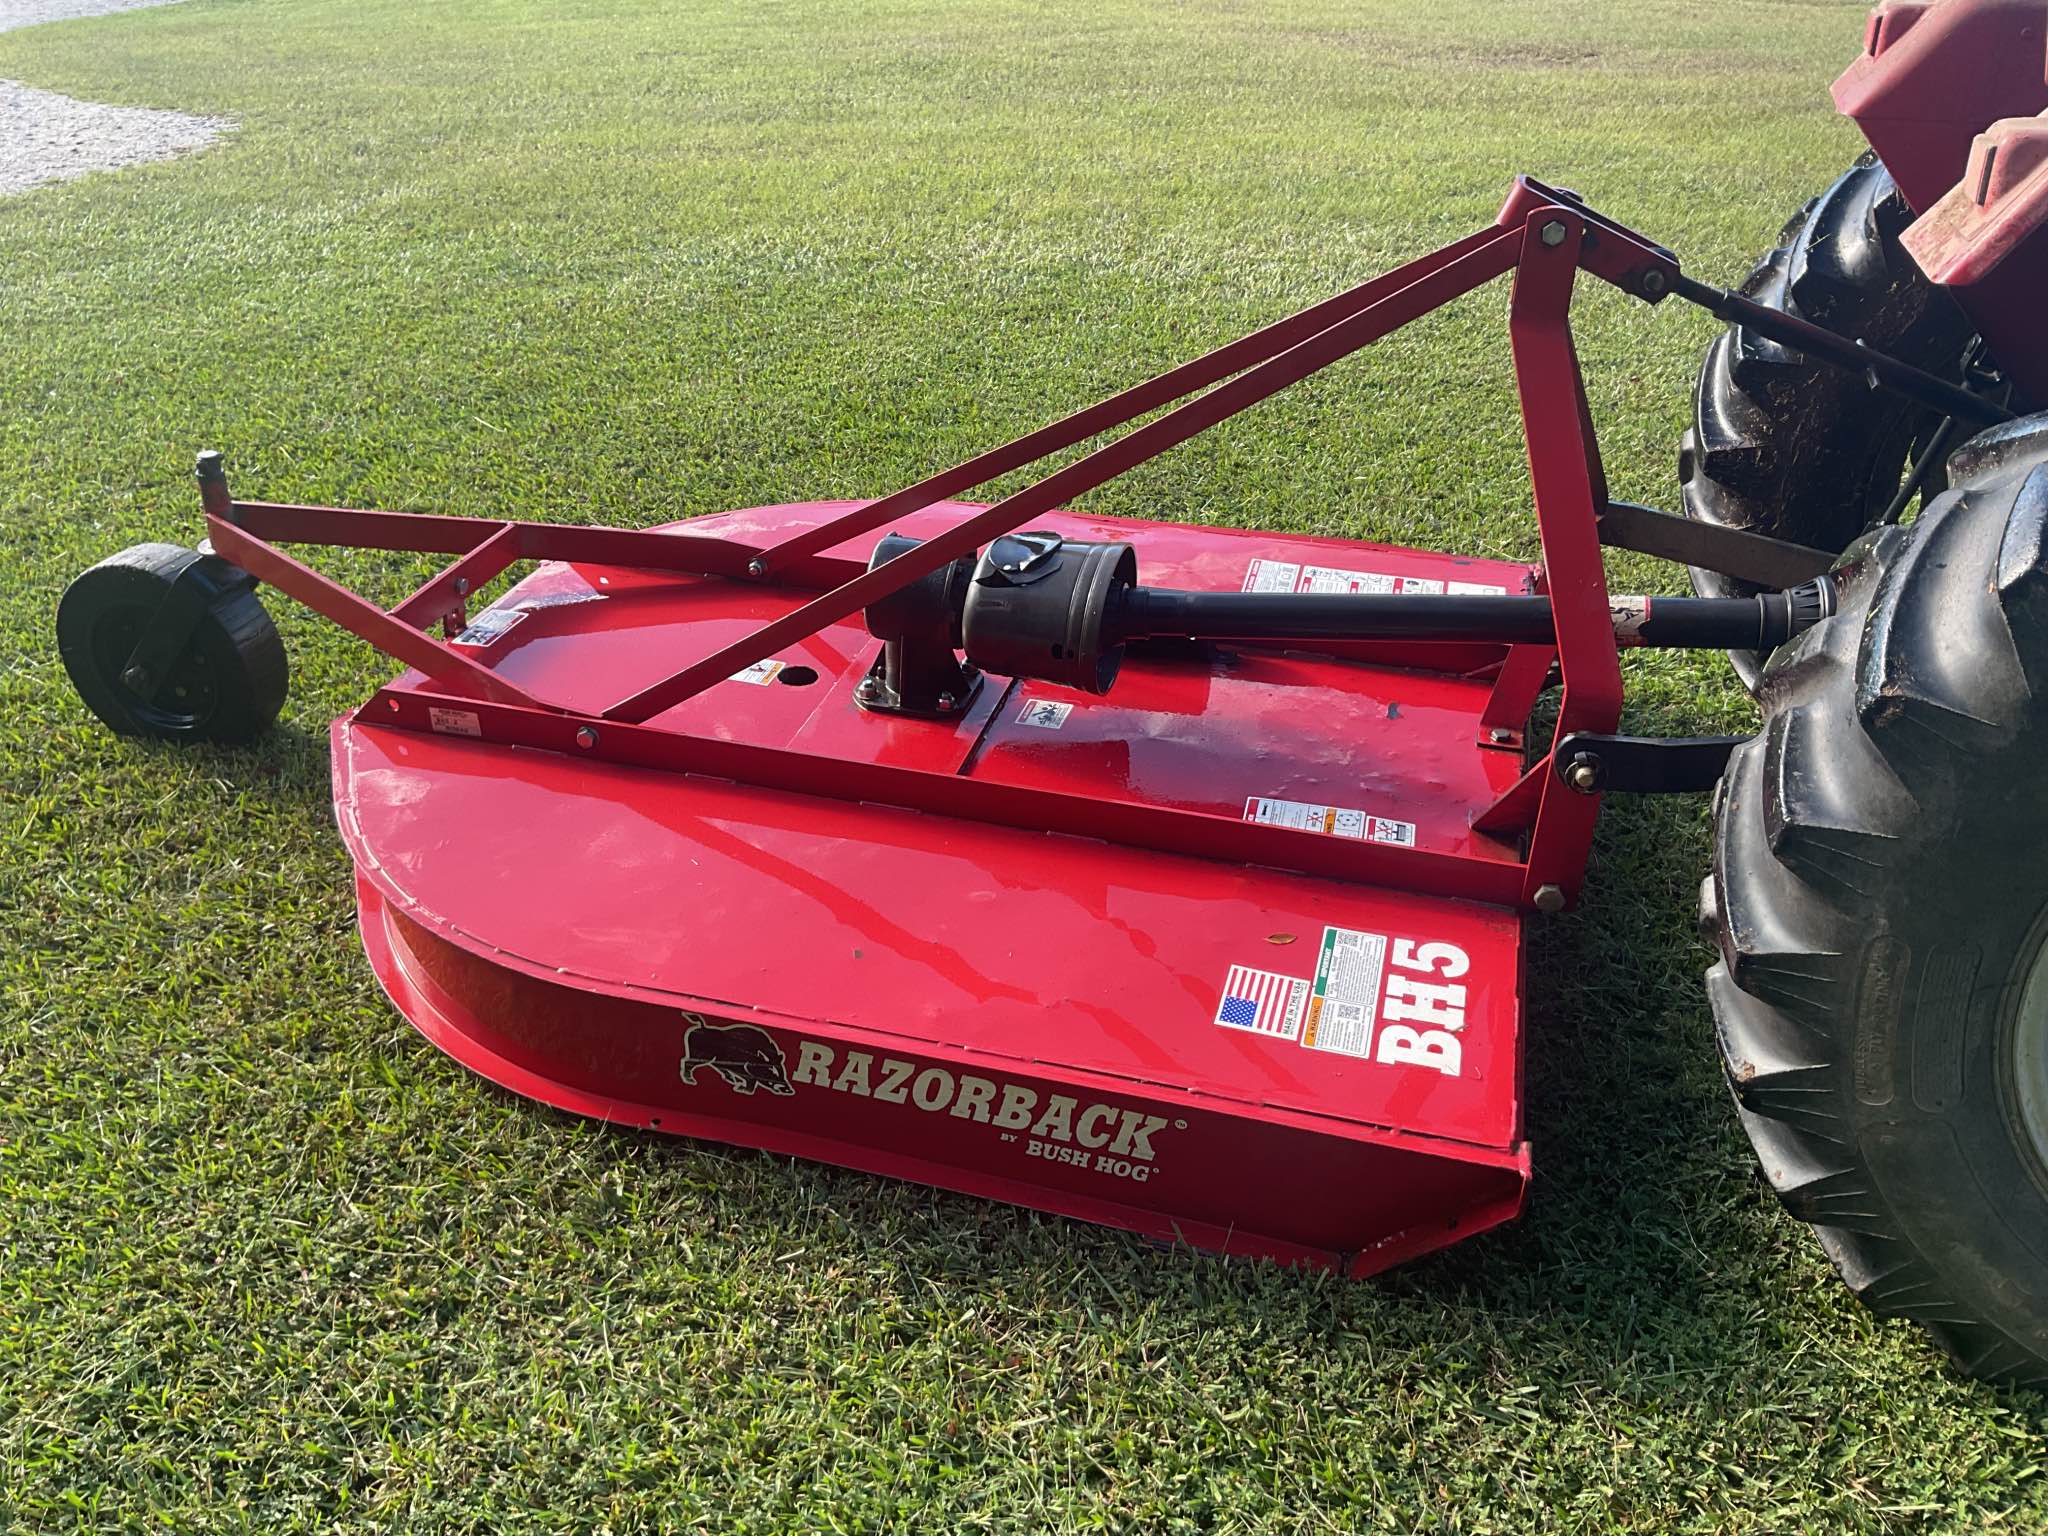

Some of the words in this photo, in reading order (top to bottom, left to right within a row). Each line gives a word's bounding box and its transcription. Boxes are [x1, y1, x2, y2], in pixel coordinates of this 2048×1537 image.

[1293, 981, 1301, 994] USA
[1287, 1008, 1294, 1016] IN
[1290, 996, 1298, 1007] THE
[1376, 937, 1470, 1077] BH5
[1283, 1017, 1293, 1035] MADE
[1310, 1005, 1320, 1029] WARNING
[792, 1041, 1168, 1161] RAZORBACK
[1000, 1133, 1018, 1143] BY
[1025, 1140, 1091, 1168] BUSH
